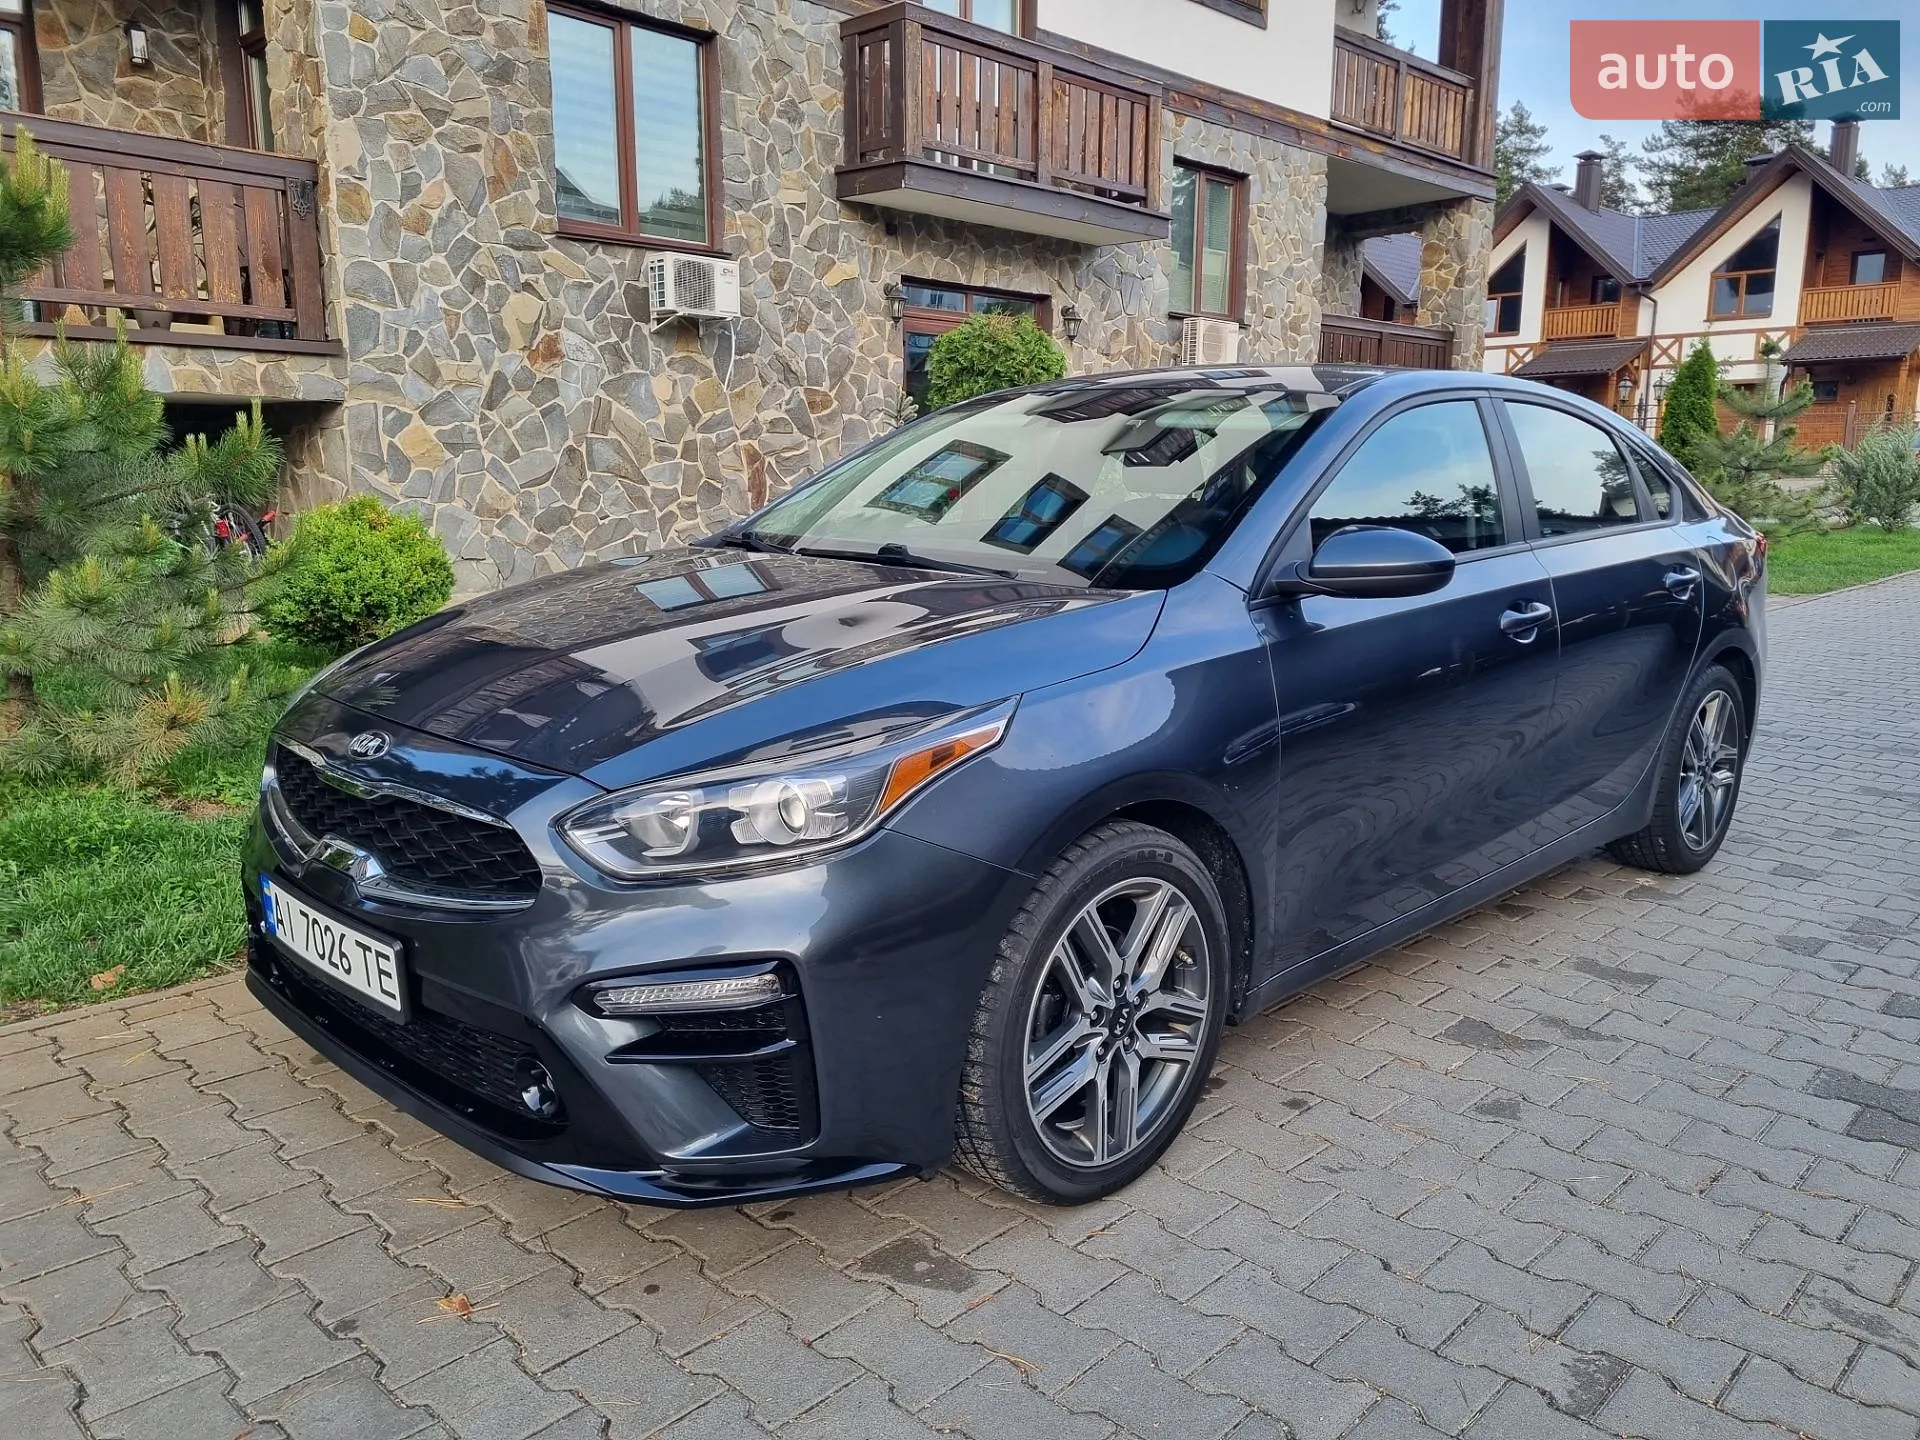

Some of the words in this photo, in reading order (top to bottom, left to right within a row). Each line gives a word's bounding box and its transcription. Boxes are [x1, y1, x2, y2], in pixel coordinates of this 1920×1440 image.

[274, 892, 294, 942] AI
[300, 909, 352, 975] 7026
[355, 940, 397, 1000] TE
[1114, 1008, 1130, 1035] KIA
